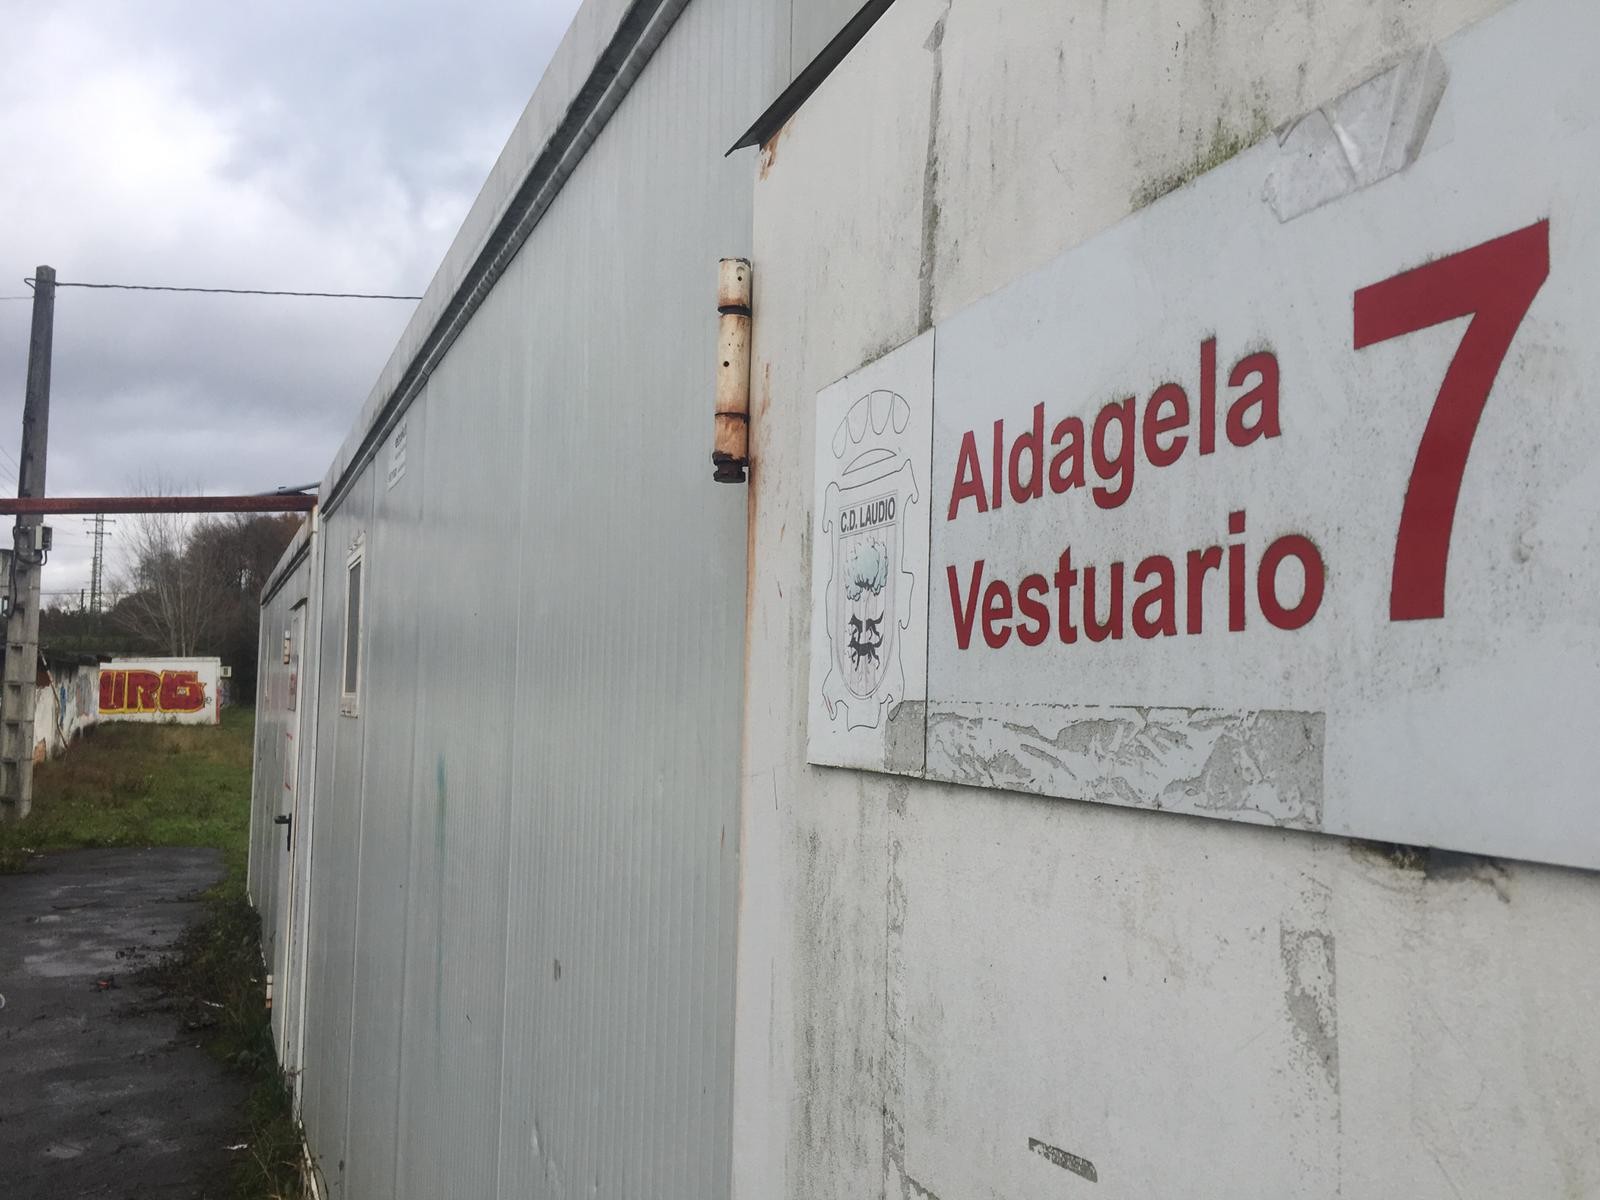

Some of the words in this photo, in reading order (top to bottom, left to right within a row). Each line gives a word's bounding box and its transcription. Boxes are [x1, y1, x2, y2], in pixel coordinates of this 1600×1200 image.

[947, 334, 1282, 522] Aldagela
[1353, 219, 1550, 621] 7
[840, 509, 858, 533] C.D.
[859, 496, 896, 528] LAUDIO
[946, 510, 1325, 651] Vestuario
